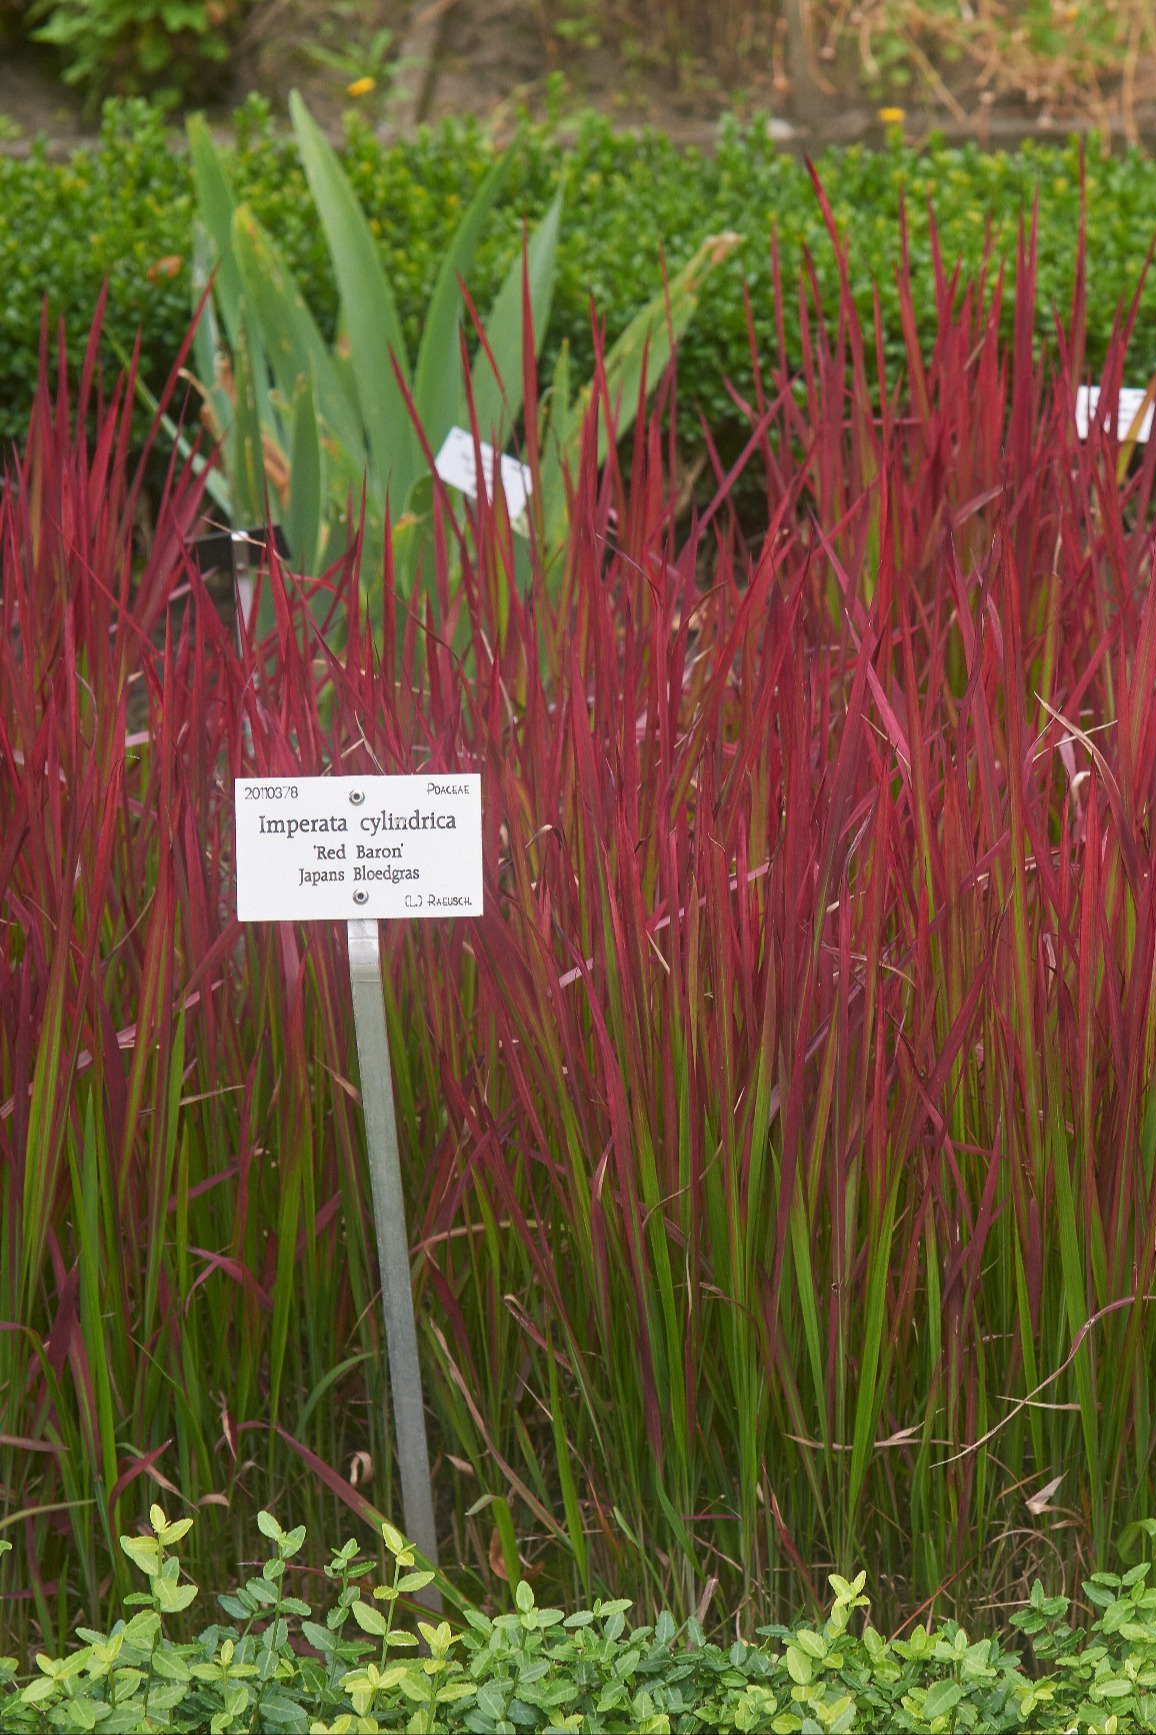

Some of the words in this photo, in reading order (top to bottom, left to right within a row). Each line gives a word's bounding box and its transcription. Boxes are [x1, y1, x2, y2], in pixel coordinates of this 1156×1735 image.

[244, 786, 298, 800] 20110378
[259, 815, 348, 838] Imperata
[360, 809, 457, 837] cylindrica
[313, 843, 346, 860] 'Red
[356, 843, 404, 859] Baron'
[298, 868, 345, 886] Japans
[353, 864, 420, 884] Bloedgras
